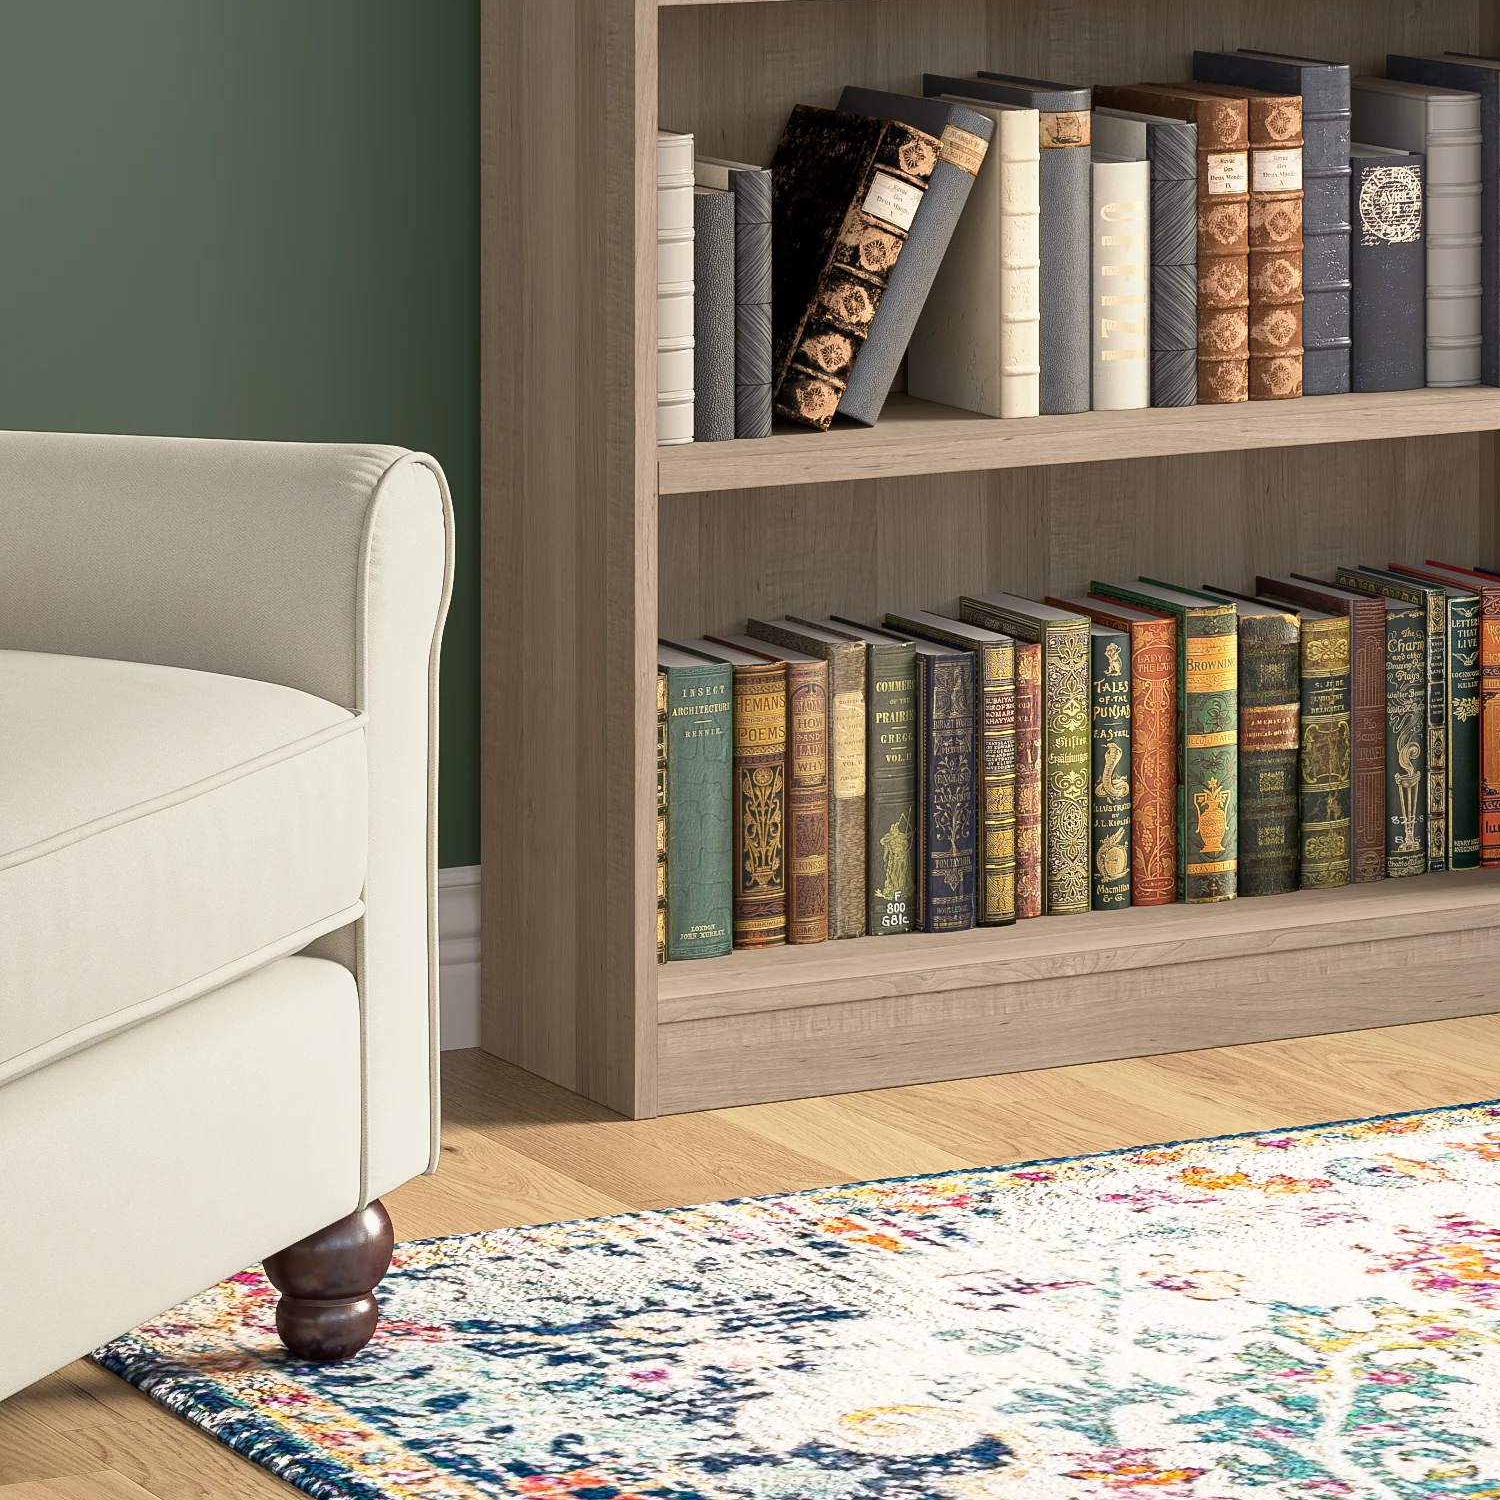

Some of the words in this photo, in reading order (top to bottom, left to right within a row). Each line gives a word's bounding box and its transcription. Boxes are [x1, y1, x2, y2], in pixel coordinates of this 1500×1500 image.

[1100, 201, 1146, 361] UFFIZI
[1457, 629, 1478, 637] THAT
[1457, 639, 1478, 649] LIVE
[1136, 653, 1163, 664] LADY
[1136, 663, 1155, 673] THE
[681, 684, 725, 698] INSECT
[1093, 678, 1129, 693] TALES
[735, 695, 786, 713] HEMANS
[796, 717, 824, 729] HOW
[737, 726, 786, 745] POEMS
[798, 743, 824, 756] LADY
[796, 760, 824, 773] WHY
[894, 891, 902, 902] F
[886, 902, 906, 914] 800
